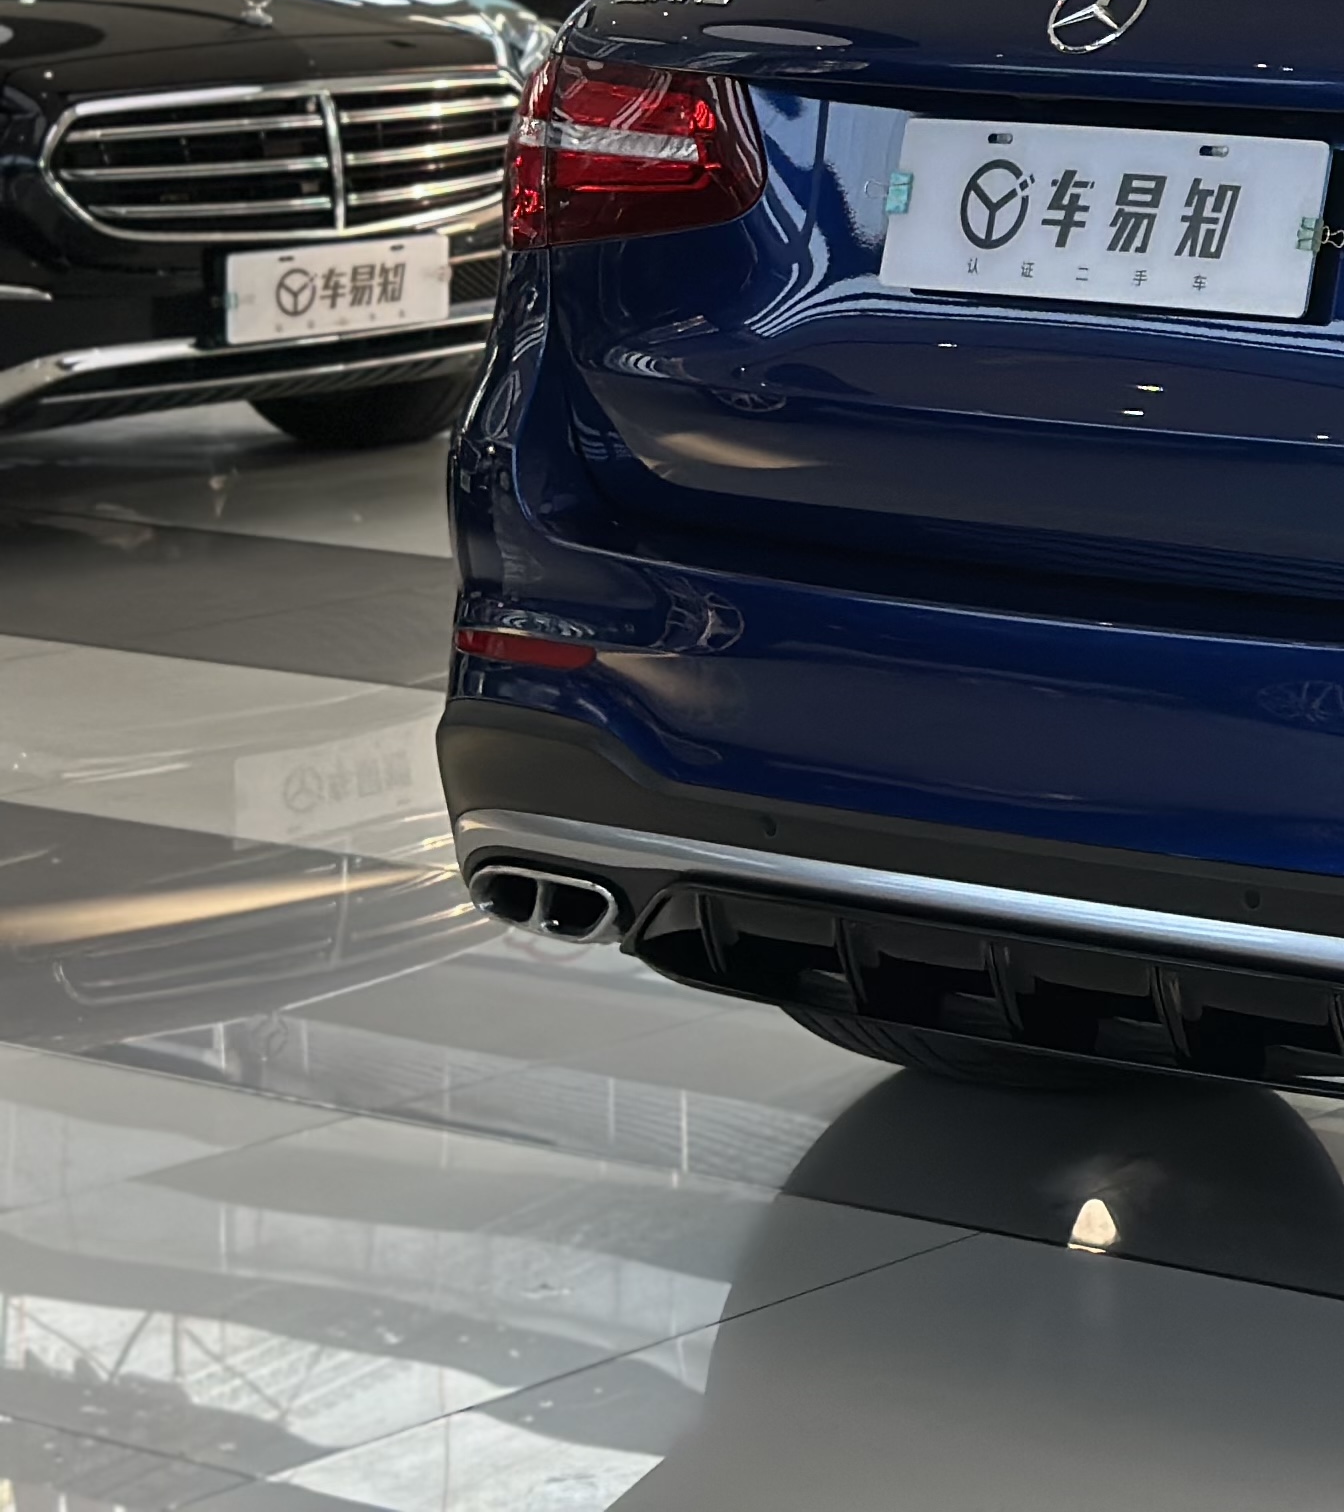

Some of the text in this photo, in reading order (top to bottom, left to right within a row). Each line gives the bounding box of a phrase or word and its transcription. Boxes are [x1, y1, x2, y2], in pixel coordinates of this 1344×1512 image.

[1040, 168, 1243, 260] 车易知
[319, 262, 406, 309] 车易知
[966, 257, 1209, 291] 认证二手车
